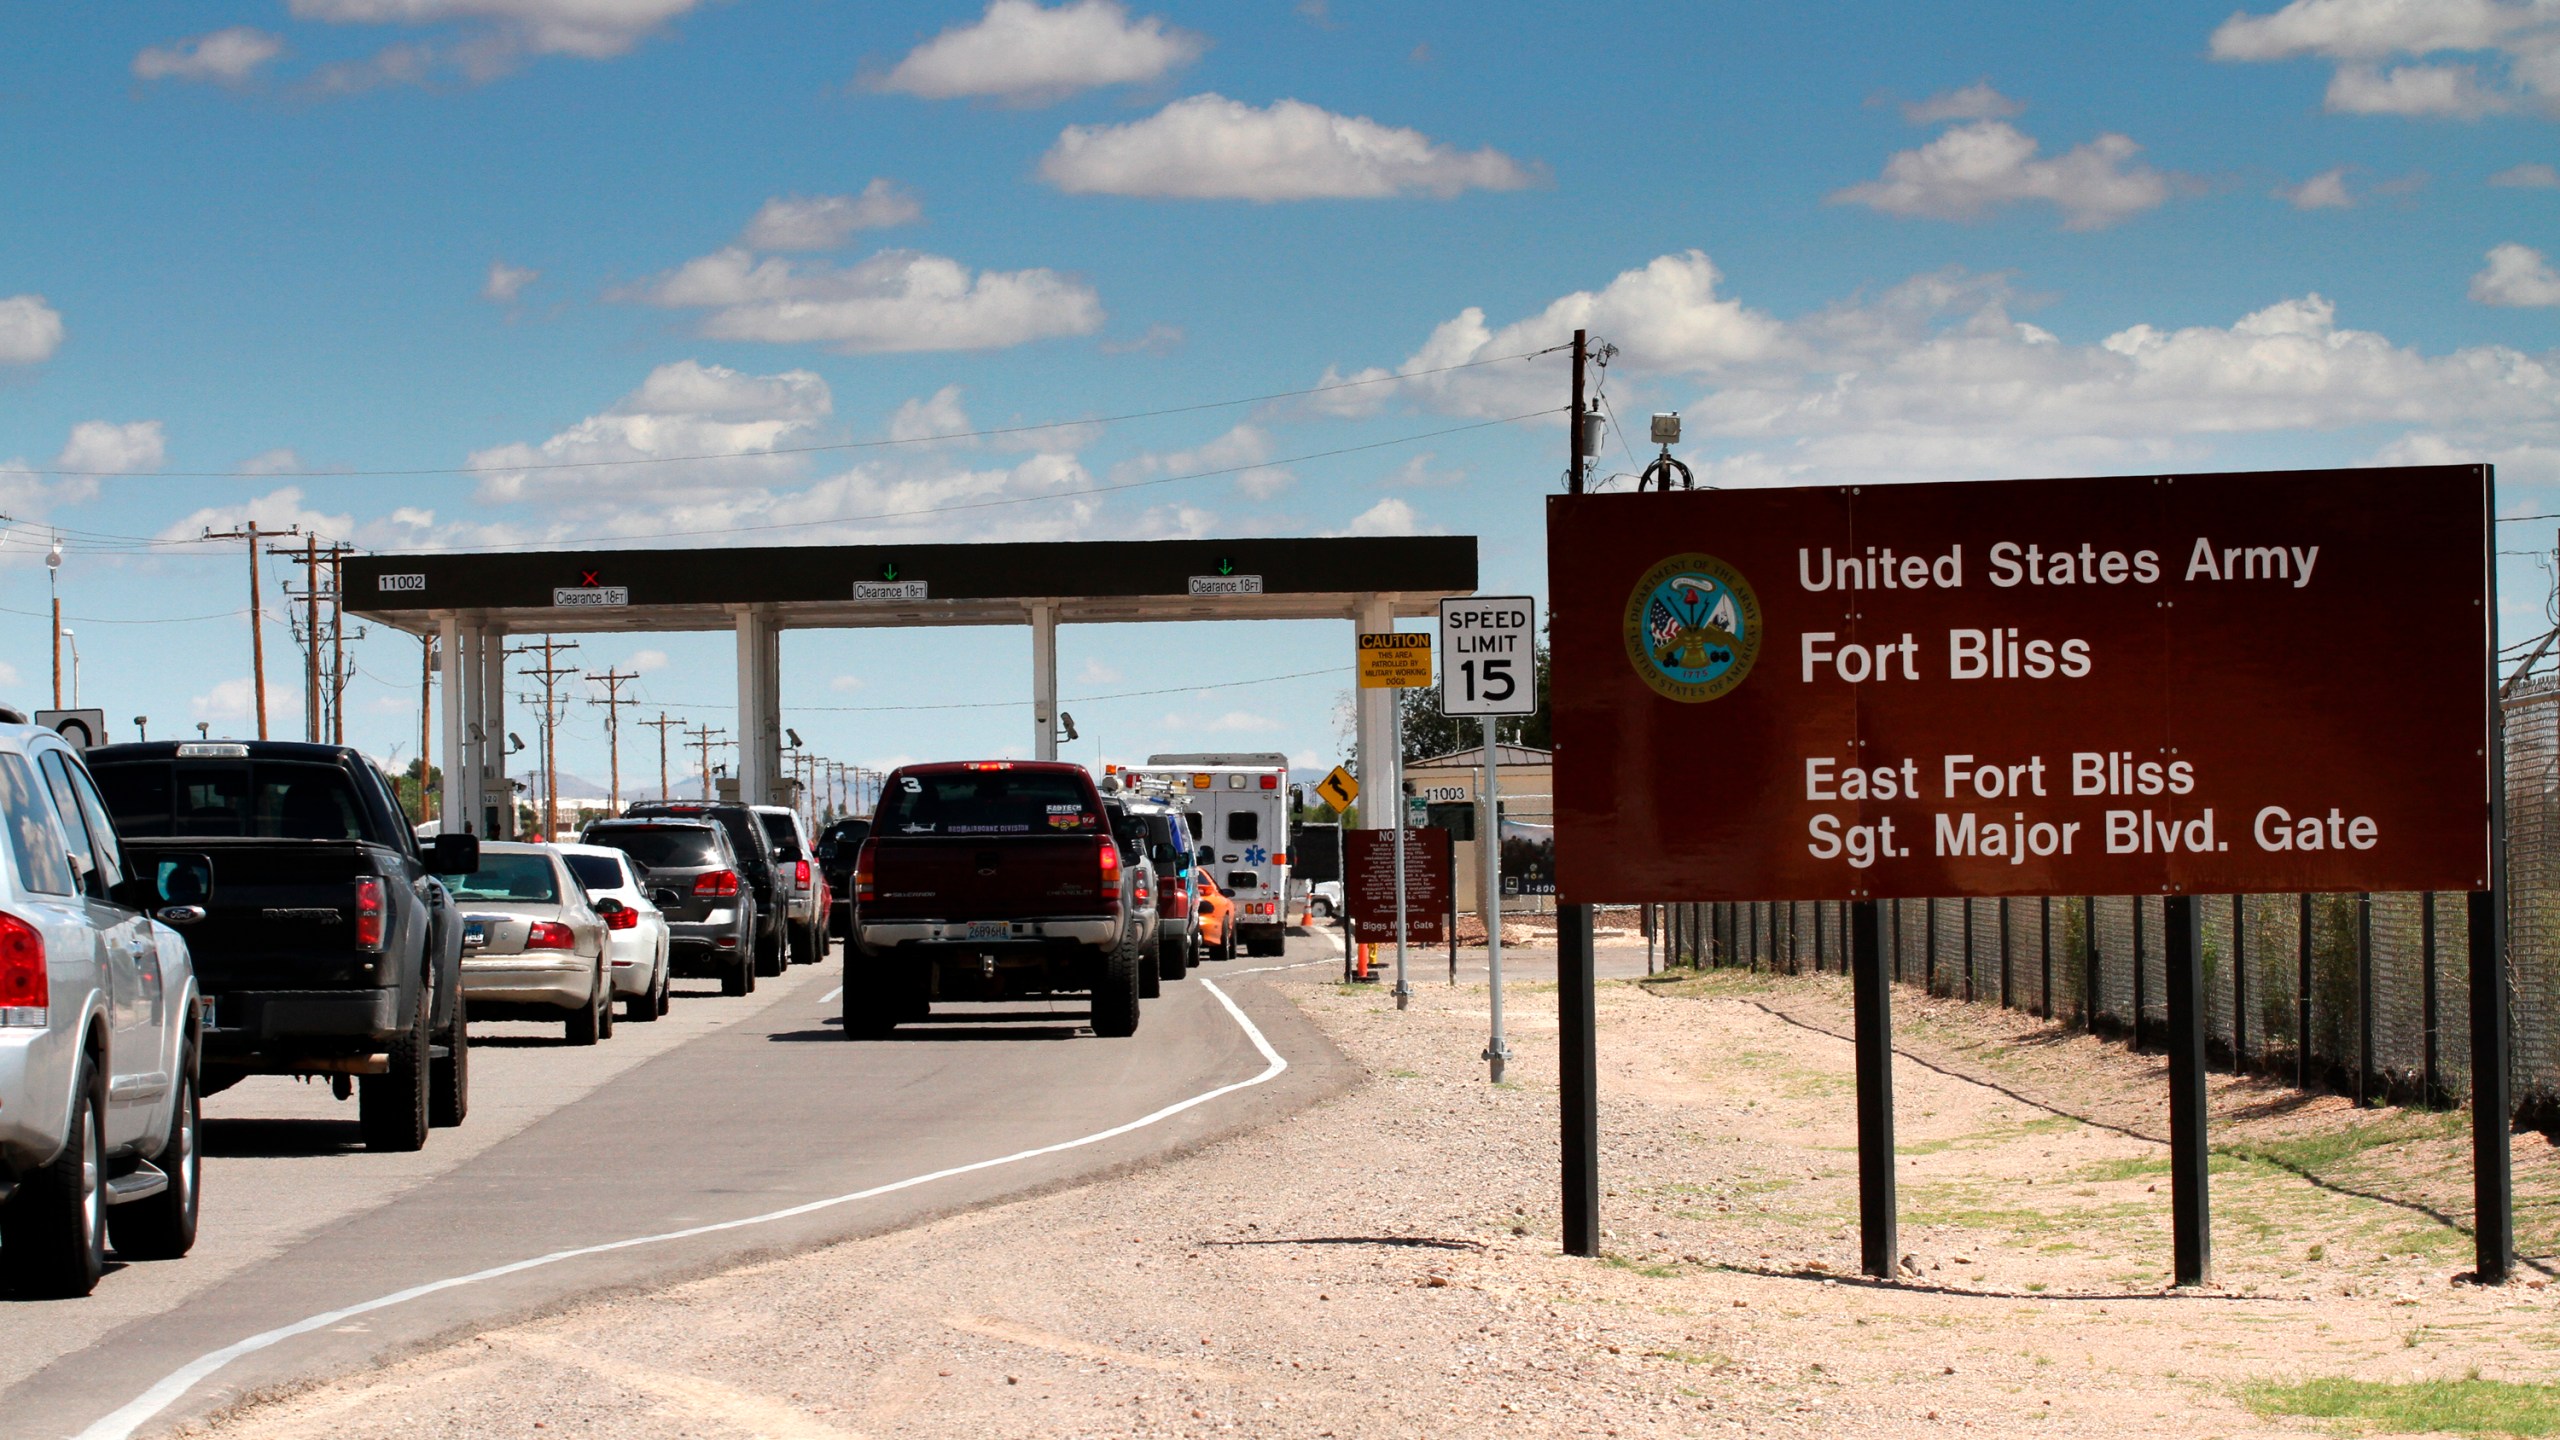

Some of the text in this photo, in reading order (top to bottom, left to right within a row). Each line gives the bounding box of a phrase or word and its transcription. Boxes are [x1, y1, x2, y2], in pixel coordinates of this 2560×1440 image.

[1800, 538, 2320, 591] United States Army
[381, 576, 423, 589] 11002
[1191, 579, 1259, 593] Clearance 18FT
[556, 590, 625, 605] Clearance 18FT
[856, 584, 924, 599] Clearance 18FT
[1631, 560, 1687, 622] DEPARTMENT
[1693, 560, 1709, 569] OF
[1714, 565, 1735, 583] THE
[1736, 587, 1758, 620] ARMY
[1449, 611, 1526, 629] SPEED
[1361, 634, 1429, 648] CAUTION
[1457, 635, 1518, 654] LIMIT
[1802, 628, 2092, 683] Fort Bliss
[1631, 631, 1758, 697] UNITED STATES OF AMERICA
[1395, 668, 1427, 676] WORKING
[1683, 670, 1709, 679] 1775
[1460, 660, 1516, 702] 15
[1807, 752, 2195, 801] East Fort Bliss
[900, 777, 922, 793] 3
[1425, 787, 1465, 800] 11003
[1379, 830, 1416, 841] NOCE
[1808, 806, 2378, 869] Sgt. Major Blvd. Gate
[170, 910, 191, 920] Ford
[1363, 920, 1434, 932] Biggs Mn Gate
